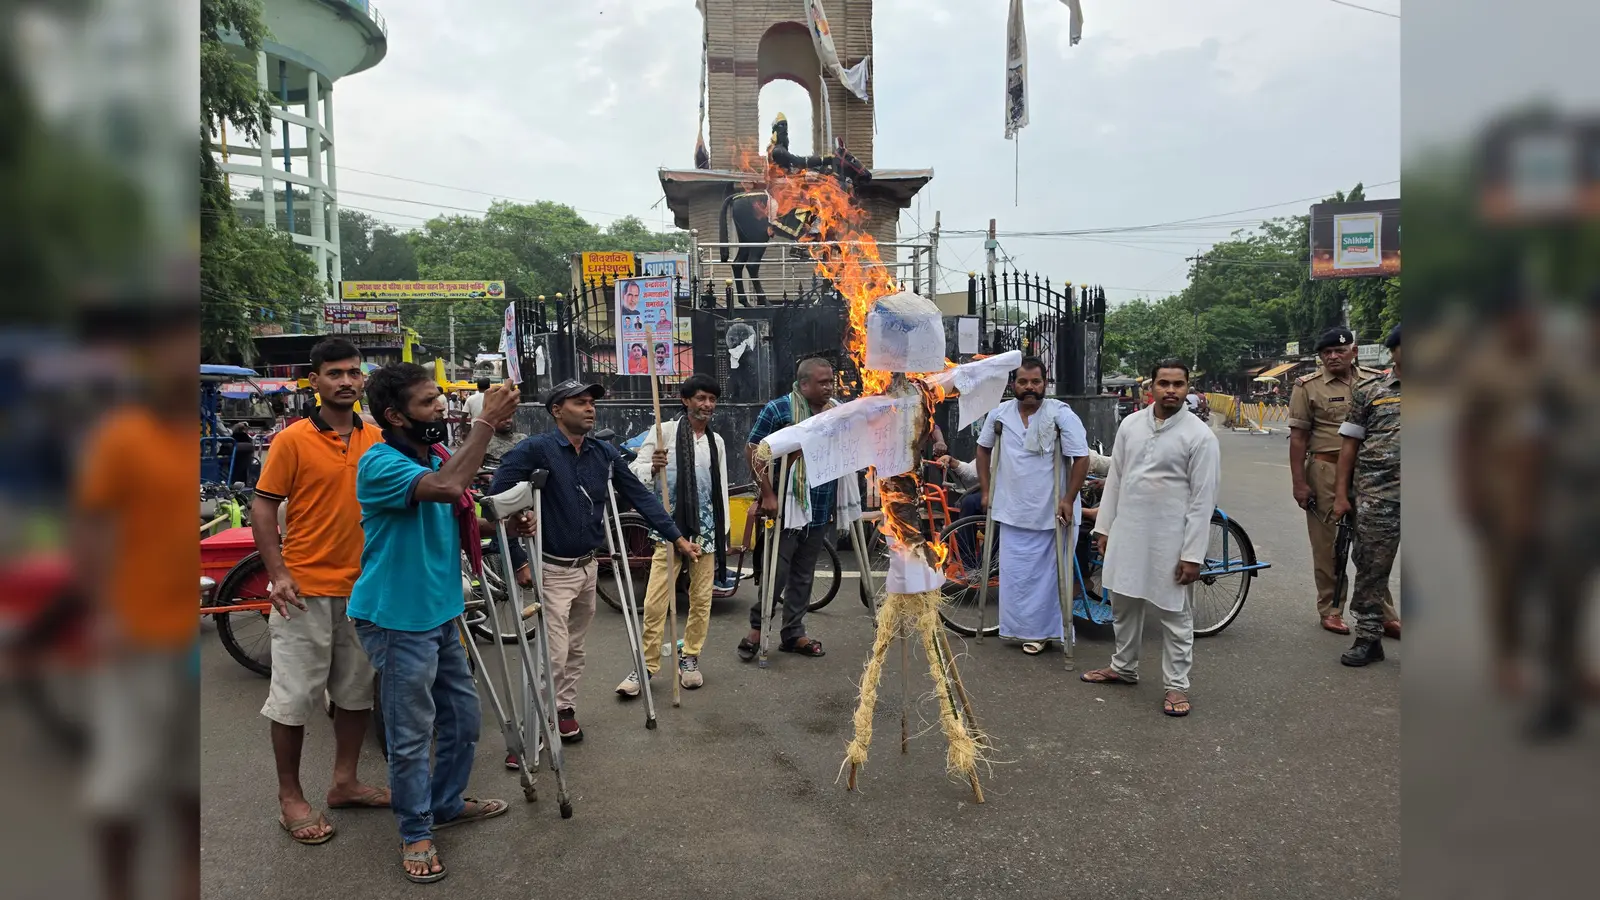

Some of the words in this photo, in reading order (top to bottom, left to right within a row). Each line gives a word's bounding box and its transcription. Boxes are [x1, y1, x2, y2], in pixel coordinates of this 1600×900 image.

[1342, 236, 1373, 245] Shikhar
[588, 252, 629, 263] शिवशक्ति
[587, 262, 630, 273] धर्मशाला
[647, 261, 675, 276] SUPER
